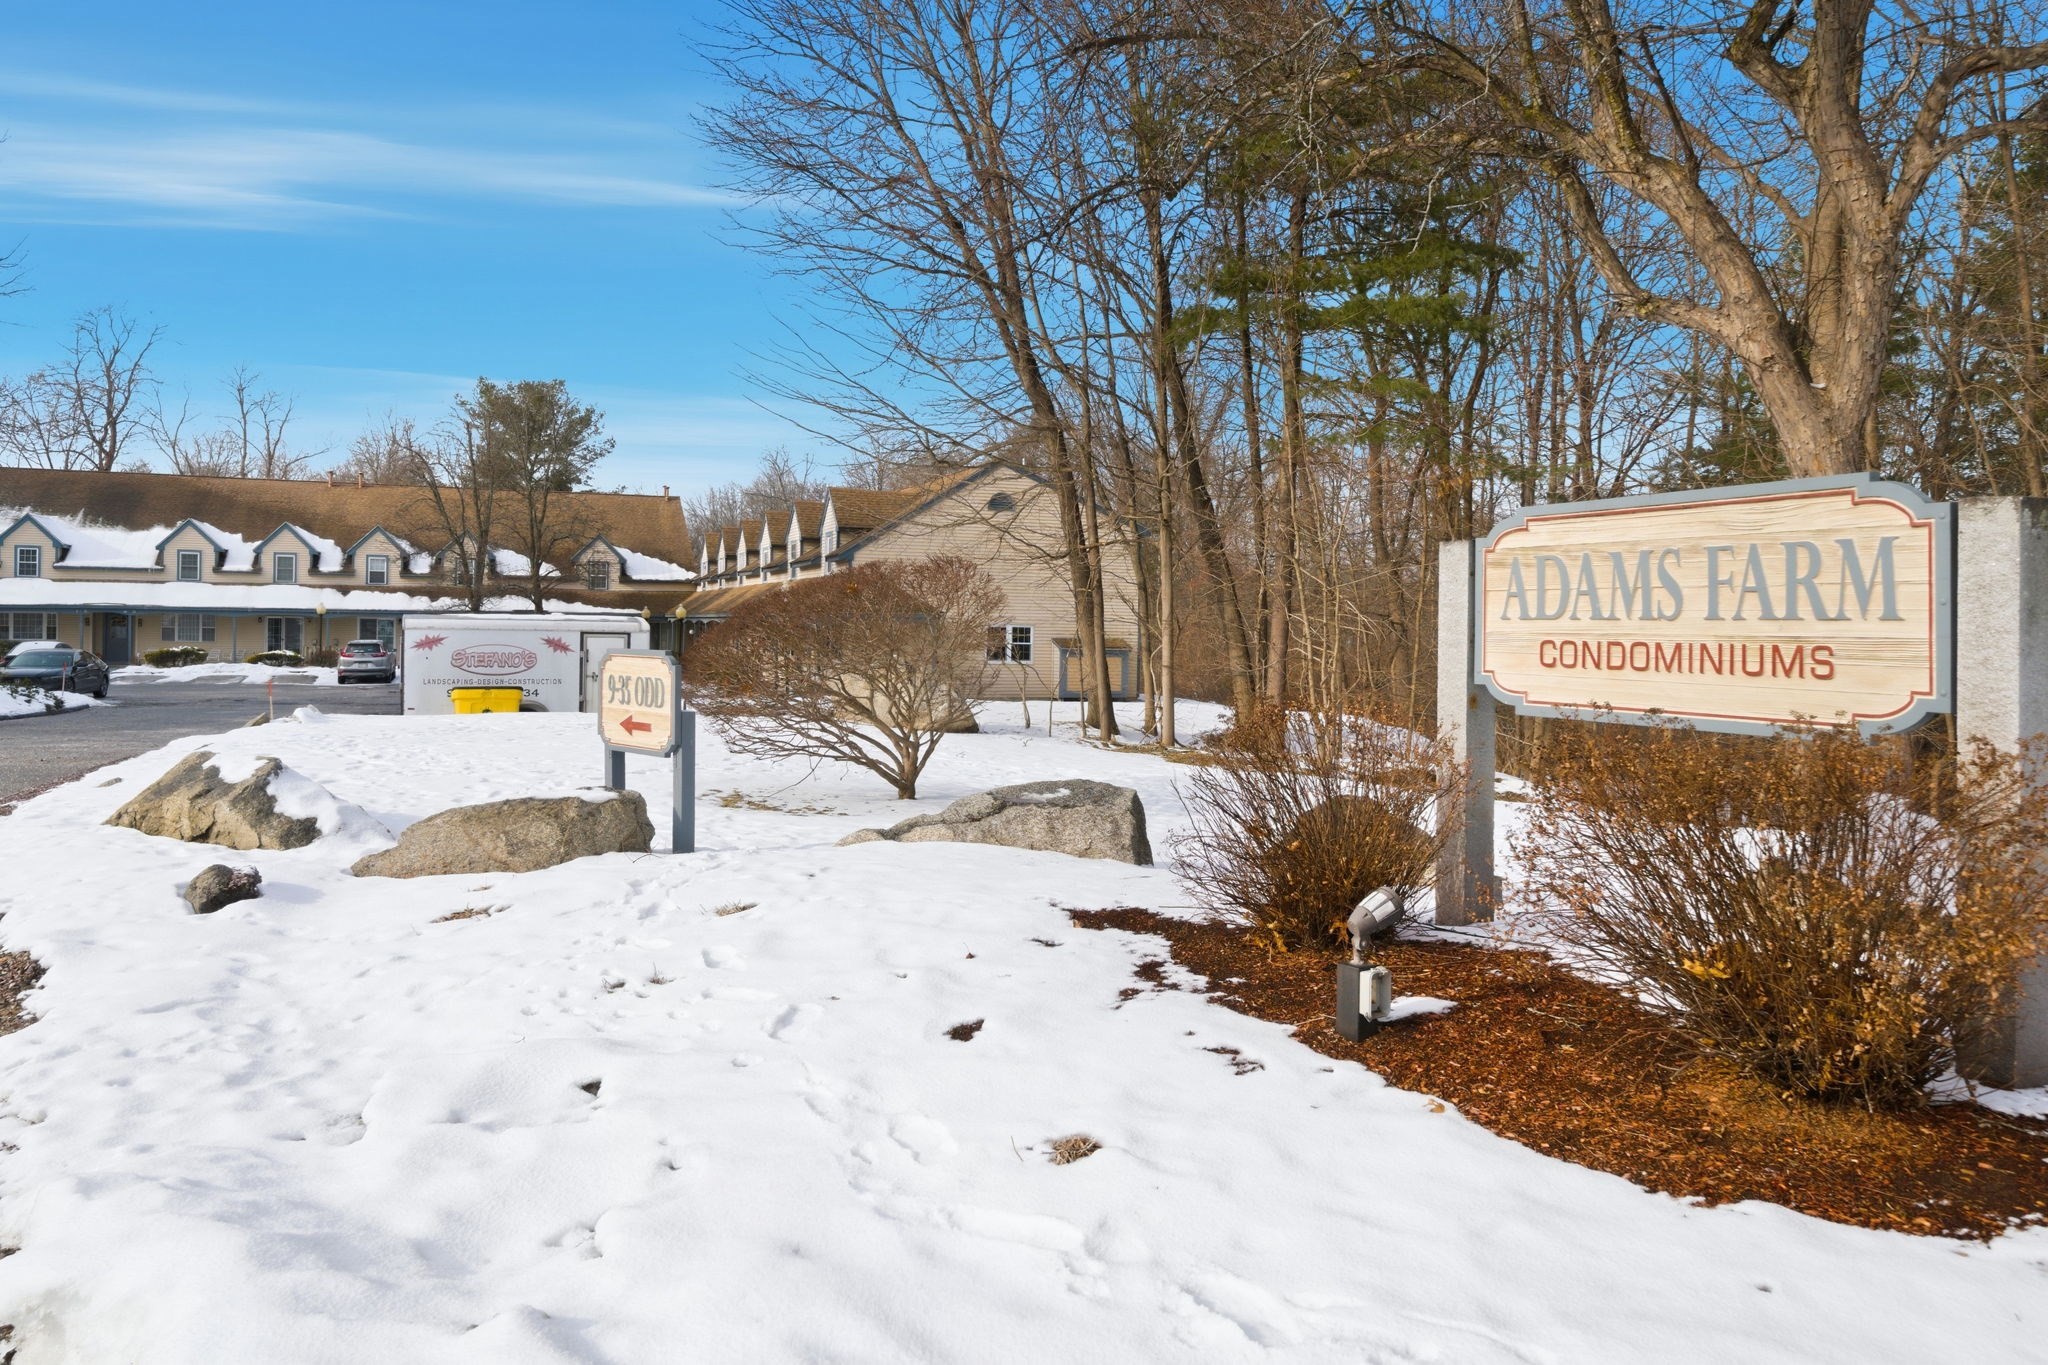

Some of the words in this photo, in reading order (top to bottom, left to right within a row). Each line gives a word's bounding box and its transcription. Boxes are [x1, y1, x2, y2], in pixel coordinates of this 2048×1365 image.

[1500, 547, 1684, 621] ADAMS
[1704, 536, 1906, 622] FARM
[450, 649, 538, 669] STEFANO'S
[1539, 639, 1835, 680] CONDOMINIUMS
[523, 688, 540, 697] 34
[608, 674, 631, 706] 9-35
[634, 676, 665, 708] ODD
